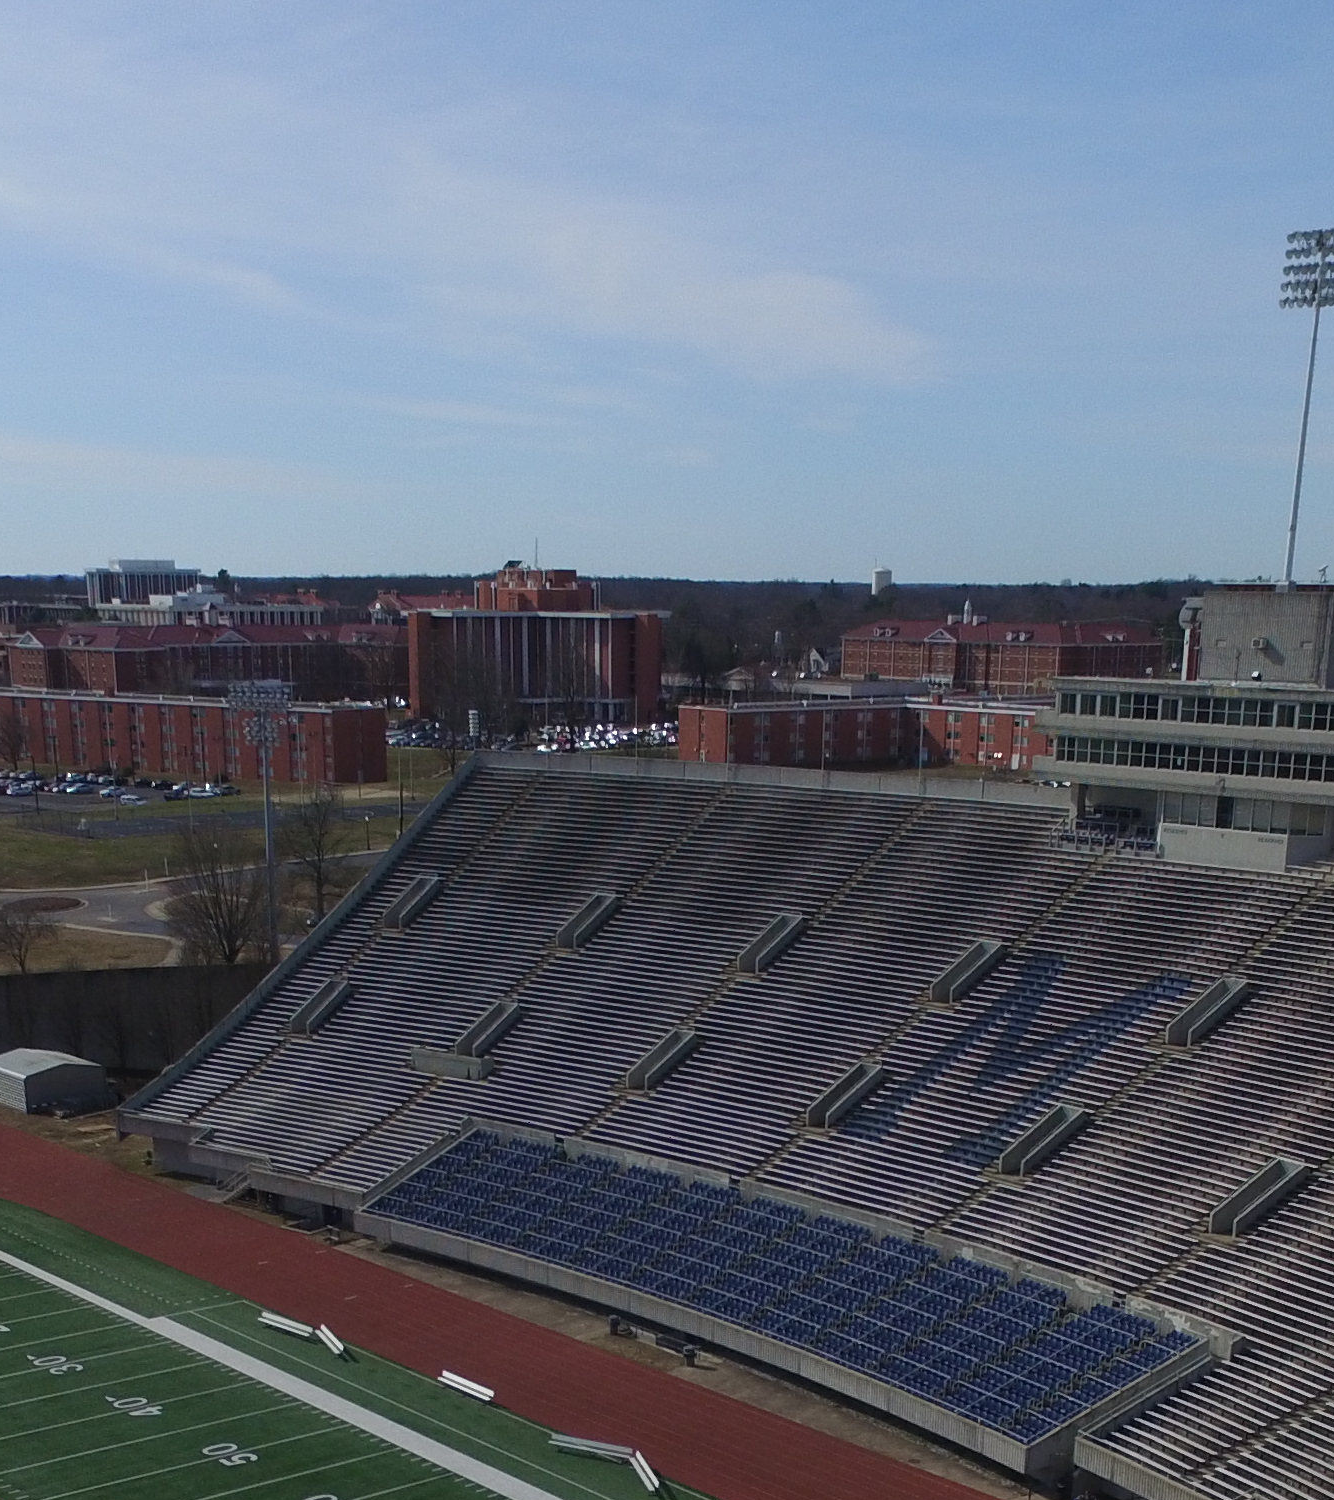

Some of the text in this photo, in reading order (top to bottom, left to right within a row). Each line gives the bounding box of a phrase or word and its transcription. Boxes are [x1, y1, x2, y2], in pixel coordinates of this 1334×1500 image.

[33, 1355, 84, 1375] 30
[113, 1396, 162, 1417] 40
[201, 1442, 259, 1467] 50
